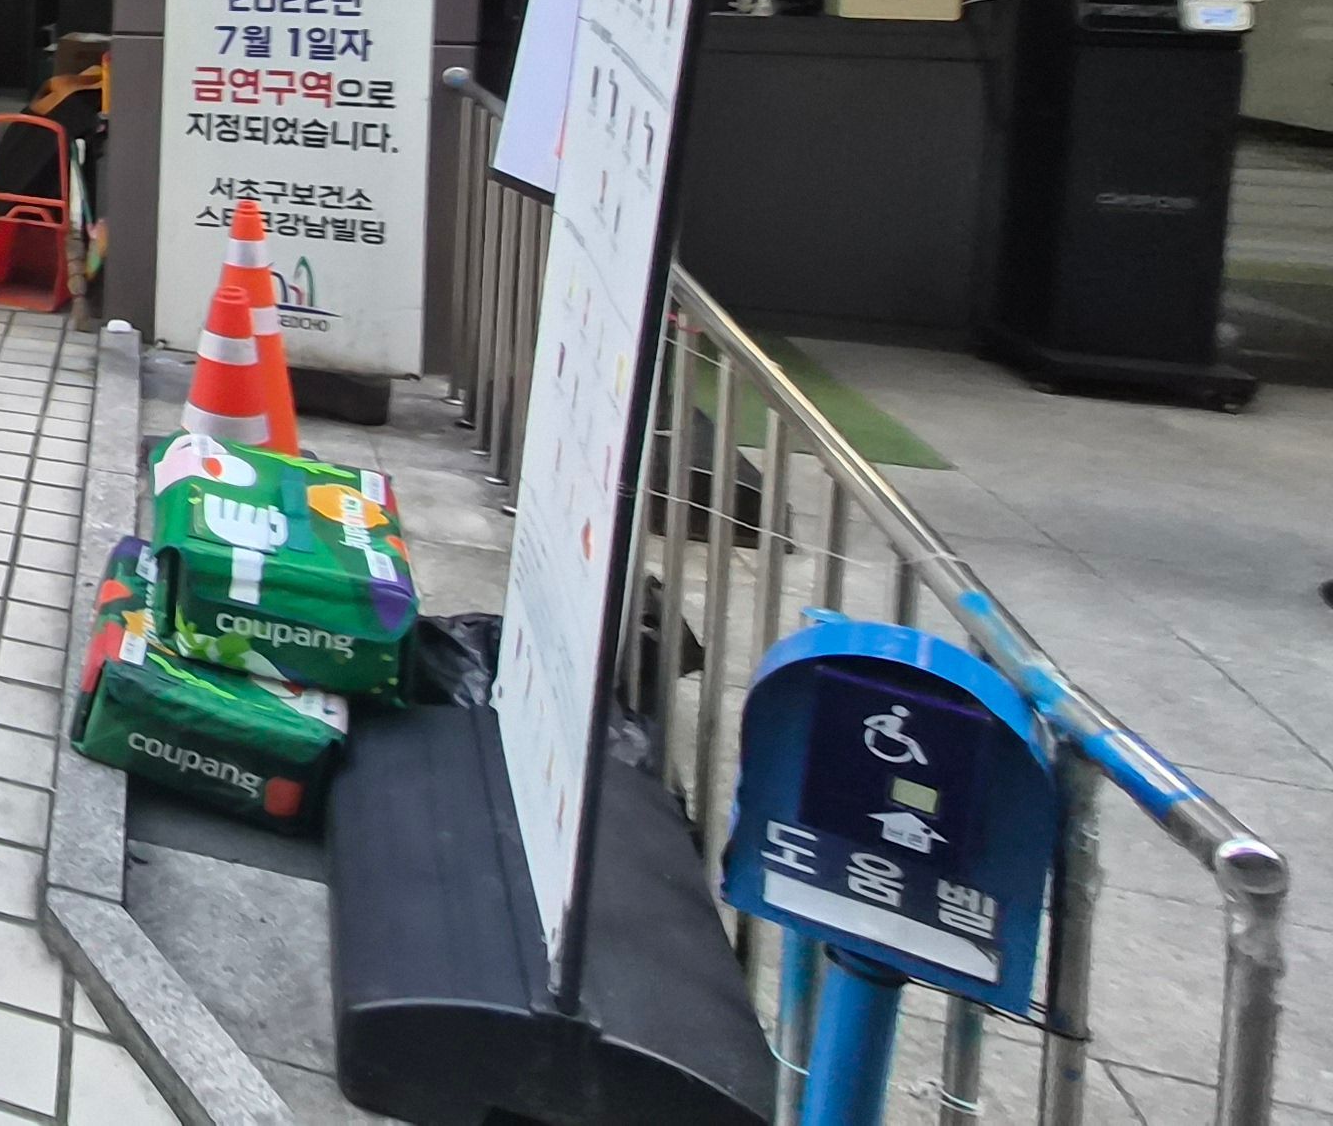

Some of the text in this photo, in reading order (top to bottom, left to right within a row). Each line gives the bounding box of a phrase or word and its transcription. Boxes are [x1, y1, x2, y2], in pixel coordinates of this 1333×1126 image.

[214, 25, 374, 62] 7월 1일자
[191, 66, 397, 110] 금연구역으로
[185, 112, 400, 154] 지정되었습니다.
[209, 177, 375, 212] 서초구보건소
[215, 611, 355, 659] coupang
[127, 731, 265, 799] coupang
